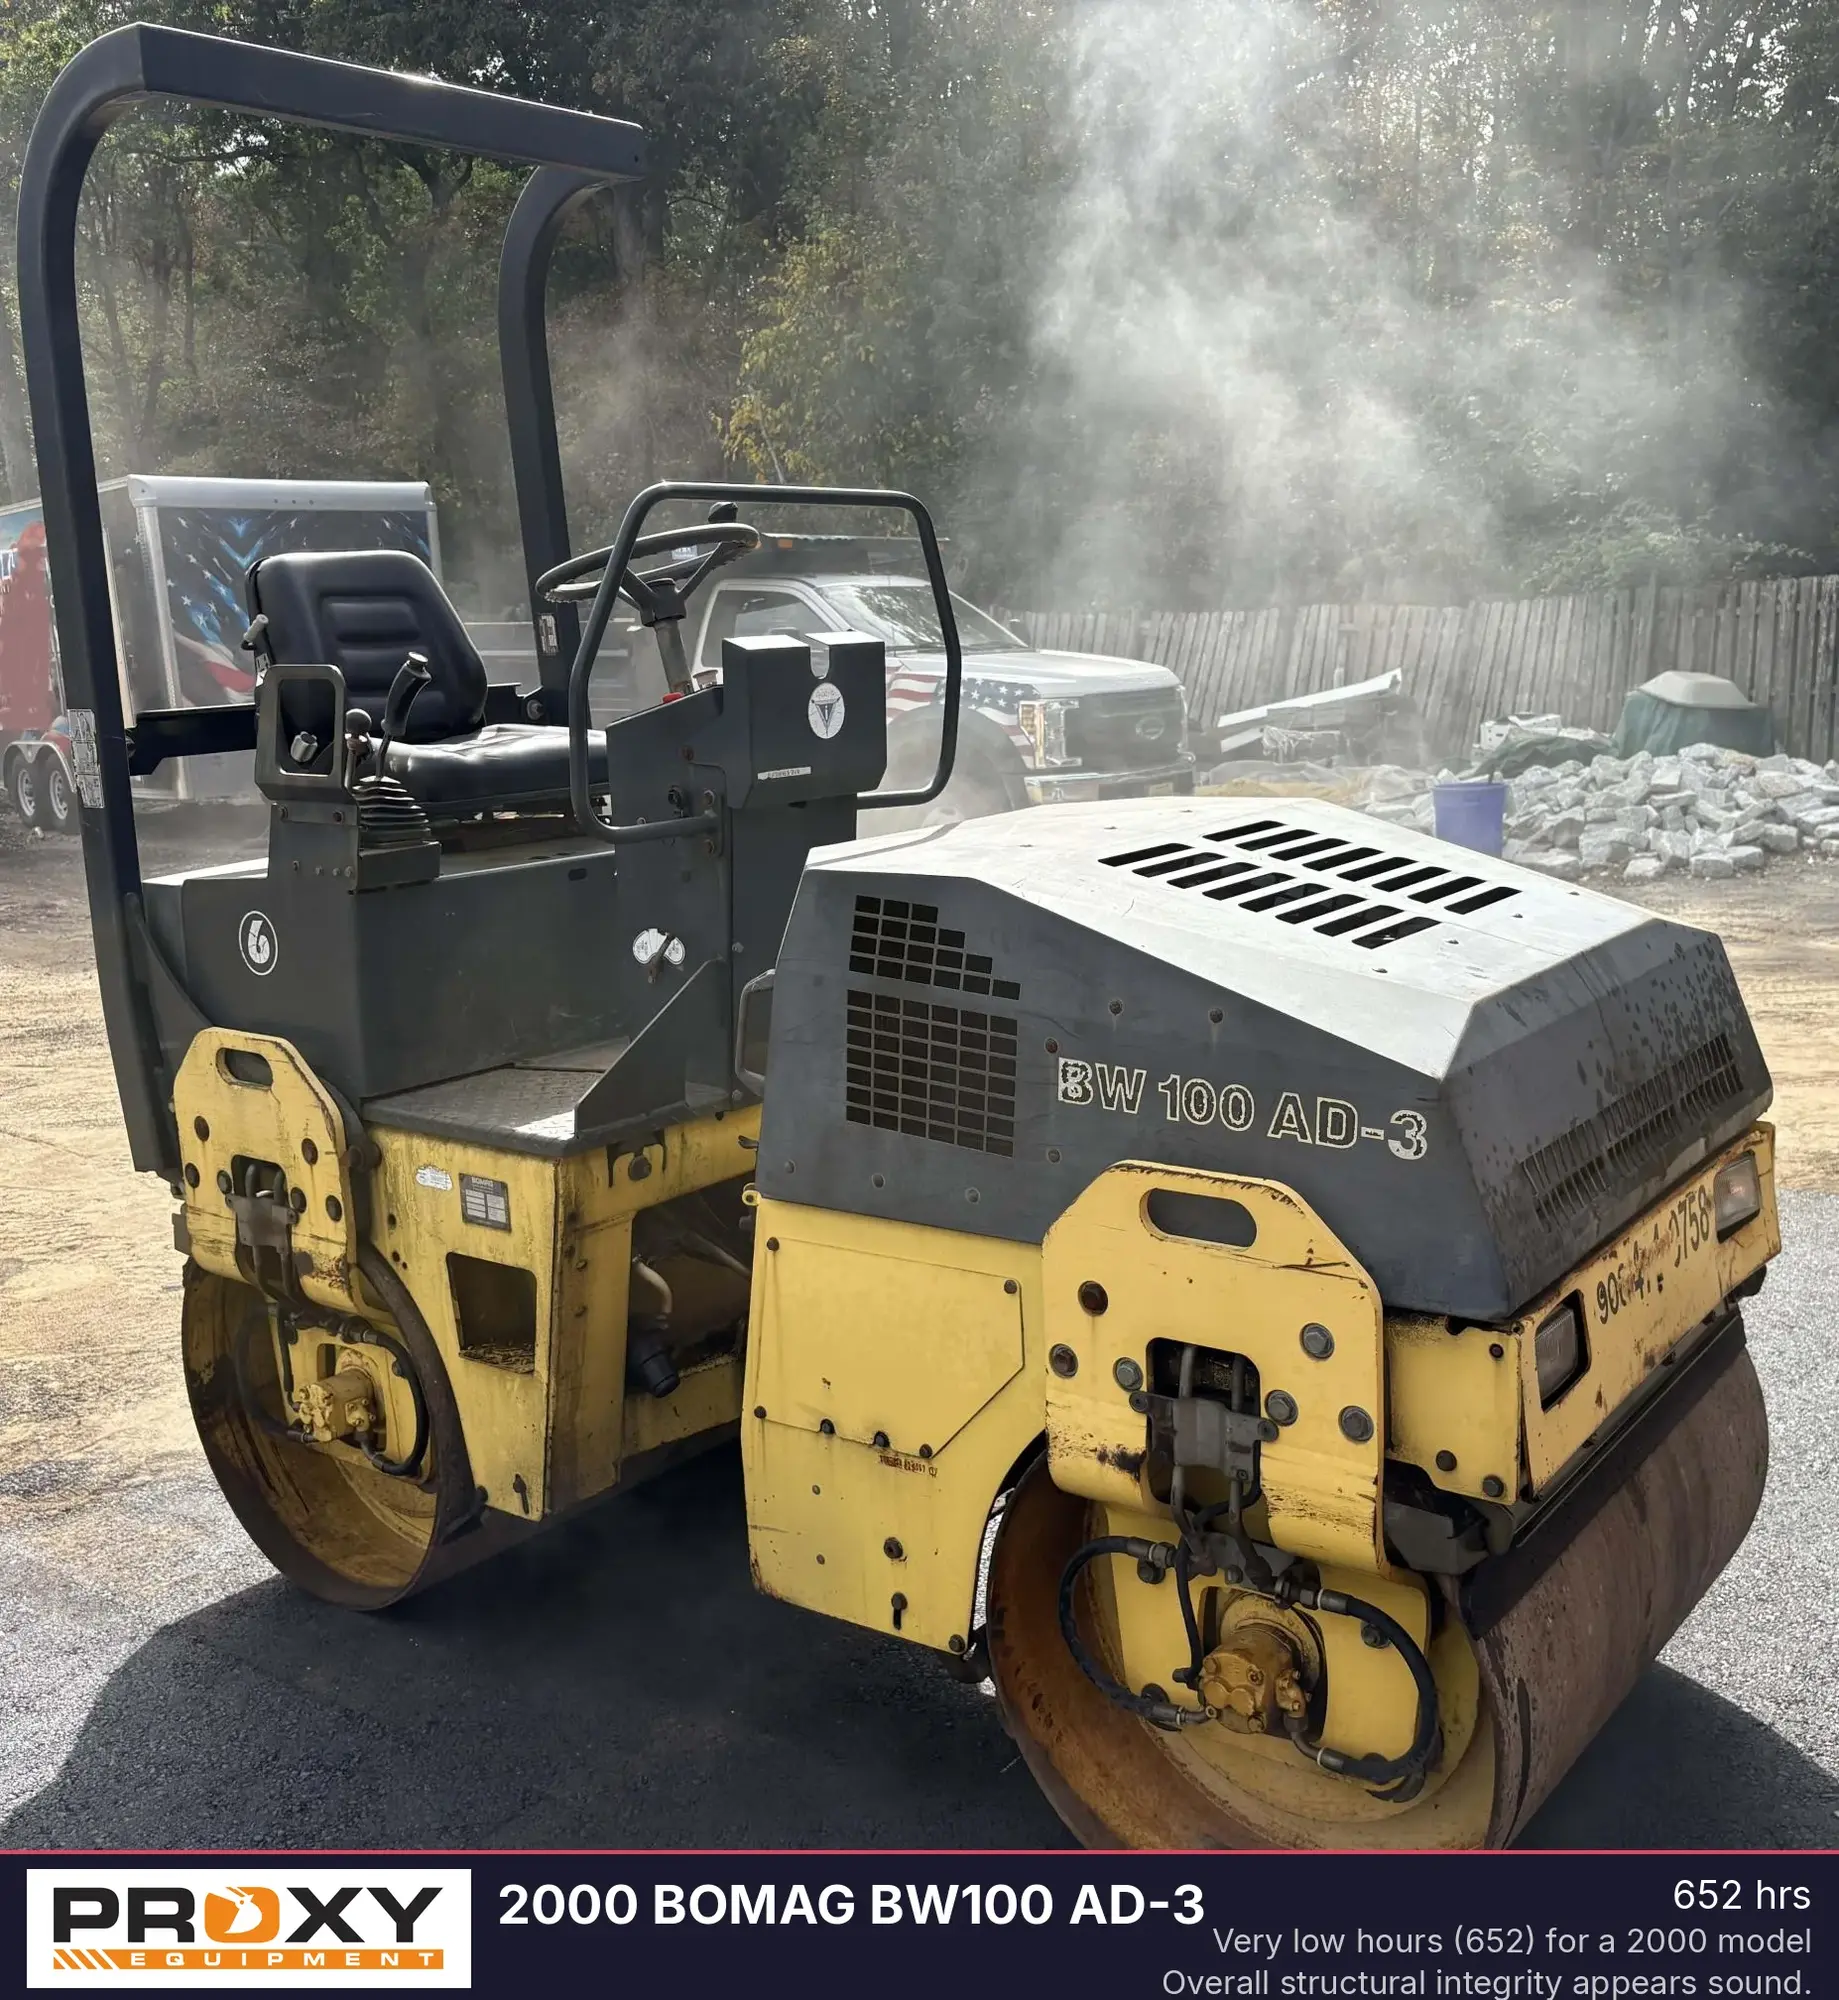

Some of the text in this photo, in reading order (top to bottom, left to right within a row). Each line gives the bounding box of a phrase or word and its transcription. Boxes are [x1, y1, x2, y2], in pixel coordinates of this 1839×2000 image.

[1057, 1057, 1428, 1160] BW 100 AD-3
